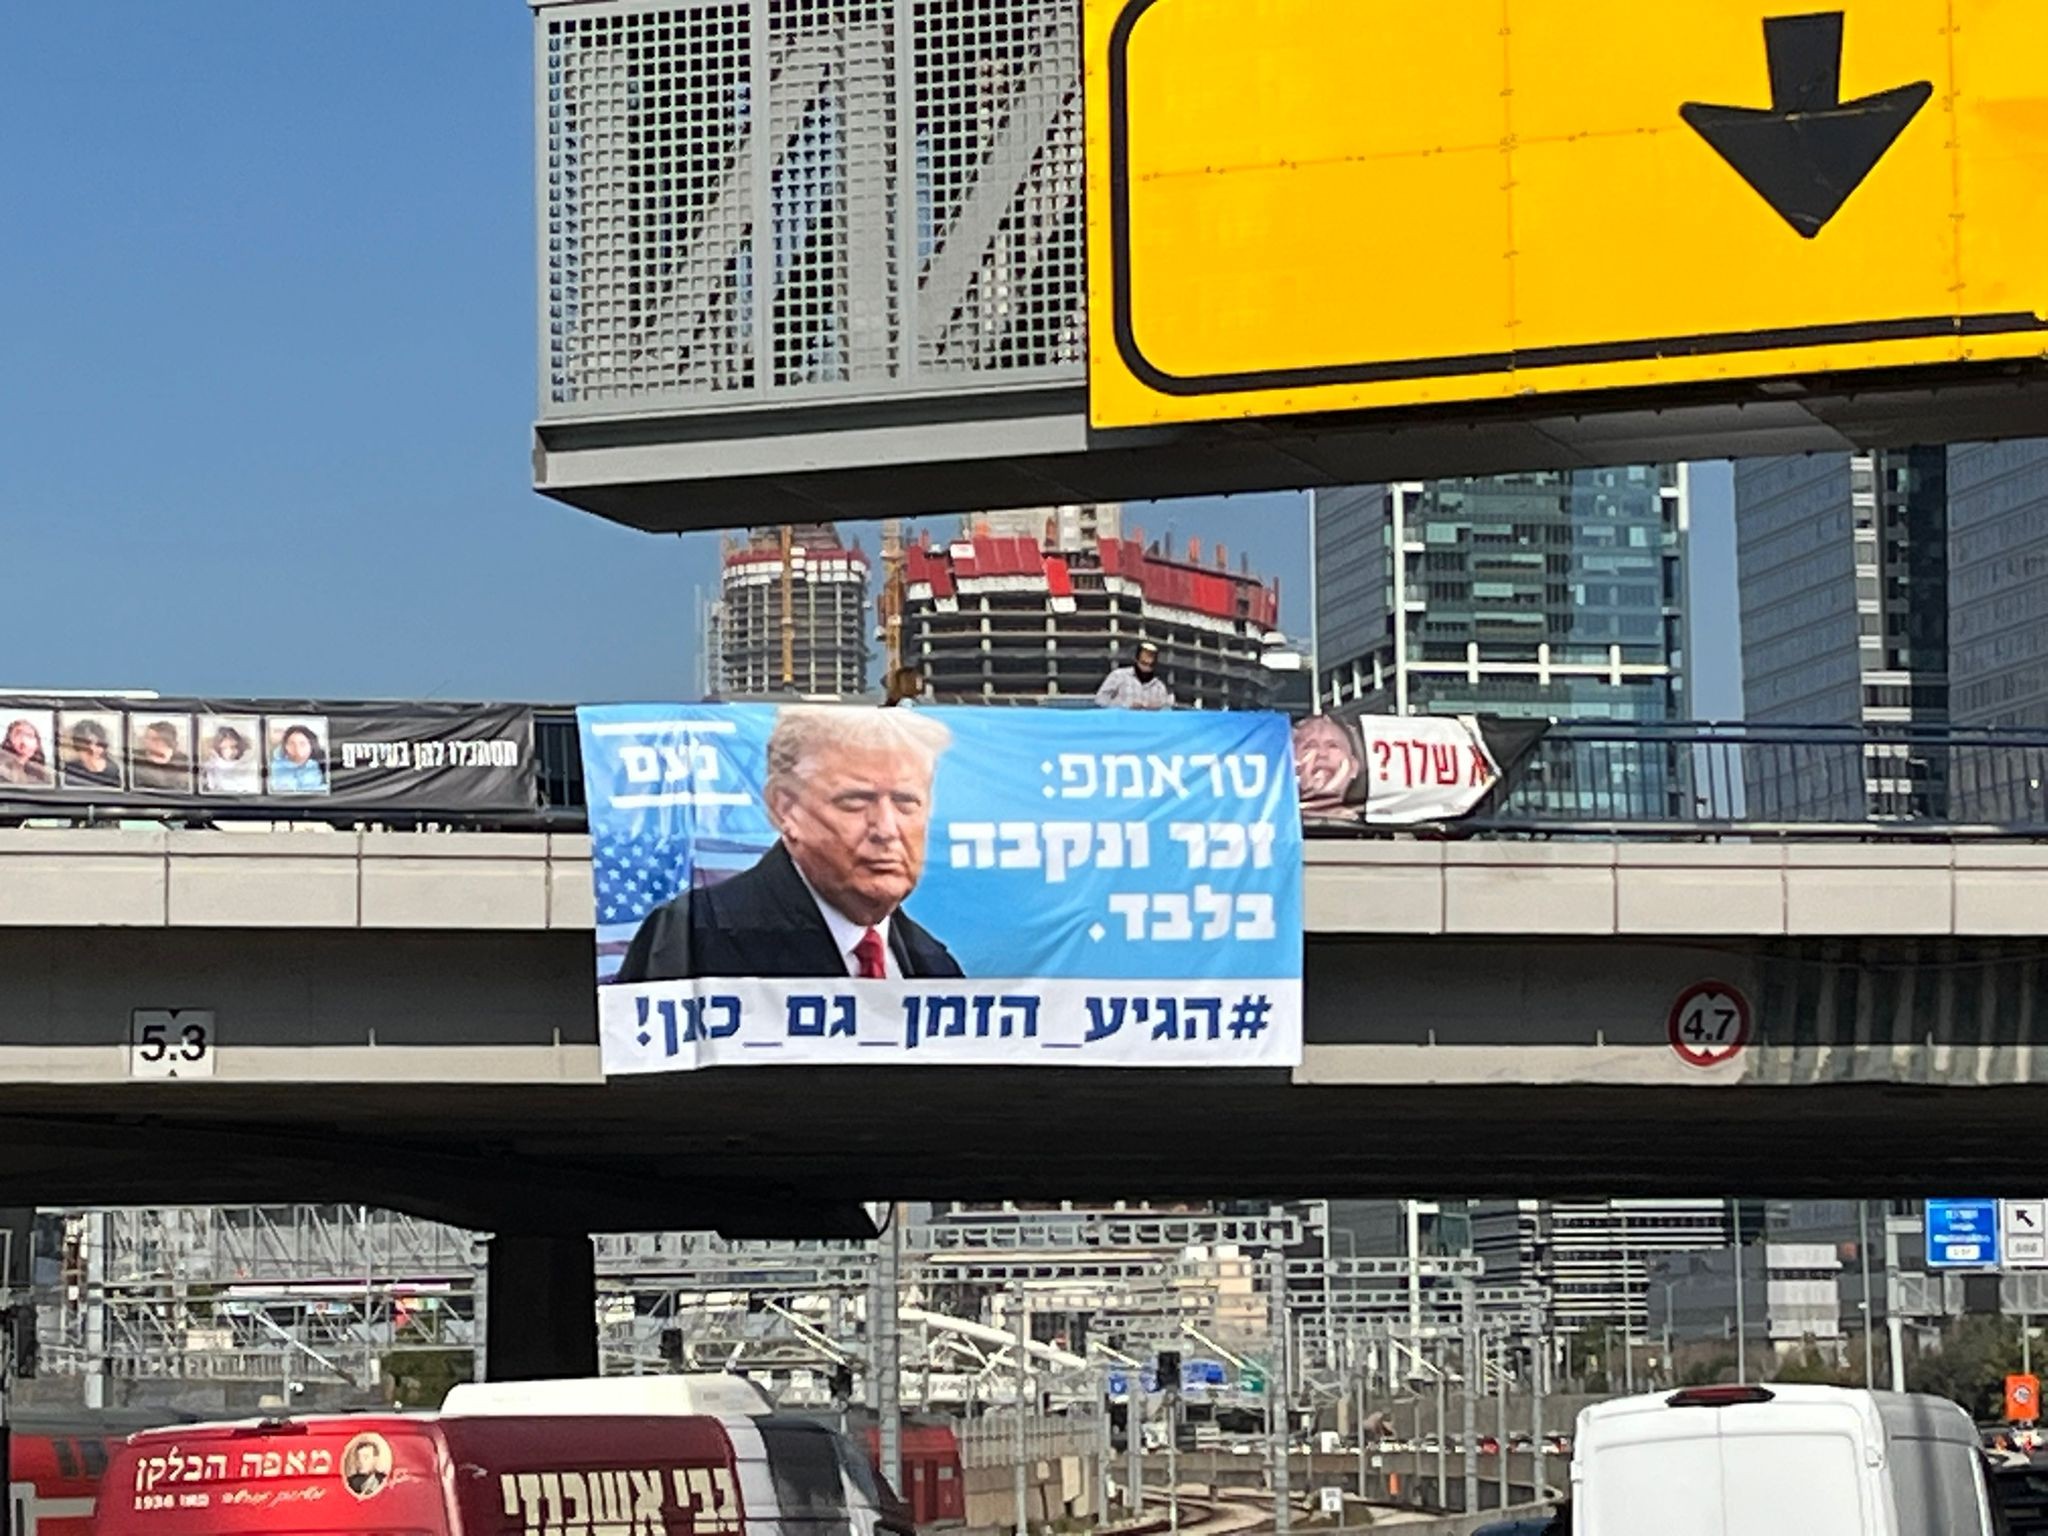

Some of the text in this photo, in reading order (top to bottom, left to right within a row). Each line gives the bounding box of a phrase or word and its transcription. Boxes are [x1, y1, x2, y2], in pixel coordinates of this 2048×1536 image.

[413, 740, 445, 771] להן
[1041, 752, 1268, 801] טראמפ:
[1372, 739, 1459, 788] שלך?
[948, 821, 1274, 883] זכר ונקבה
[1087, 885, 1276, 942] בלבד.
[140, 1024, 207, 1062] 5.3
[1683, 1008, 1736, 1041] 4.7
[134, 1445, 333, 1492] מאפה הבלקן
[672, 1467, 739, 1533] גבי
